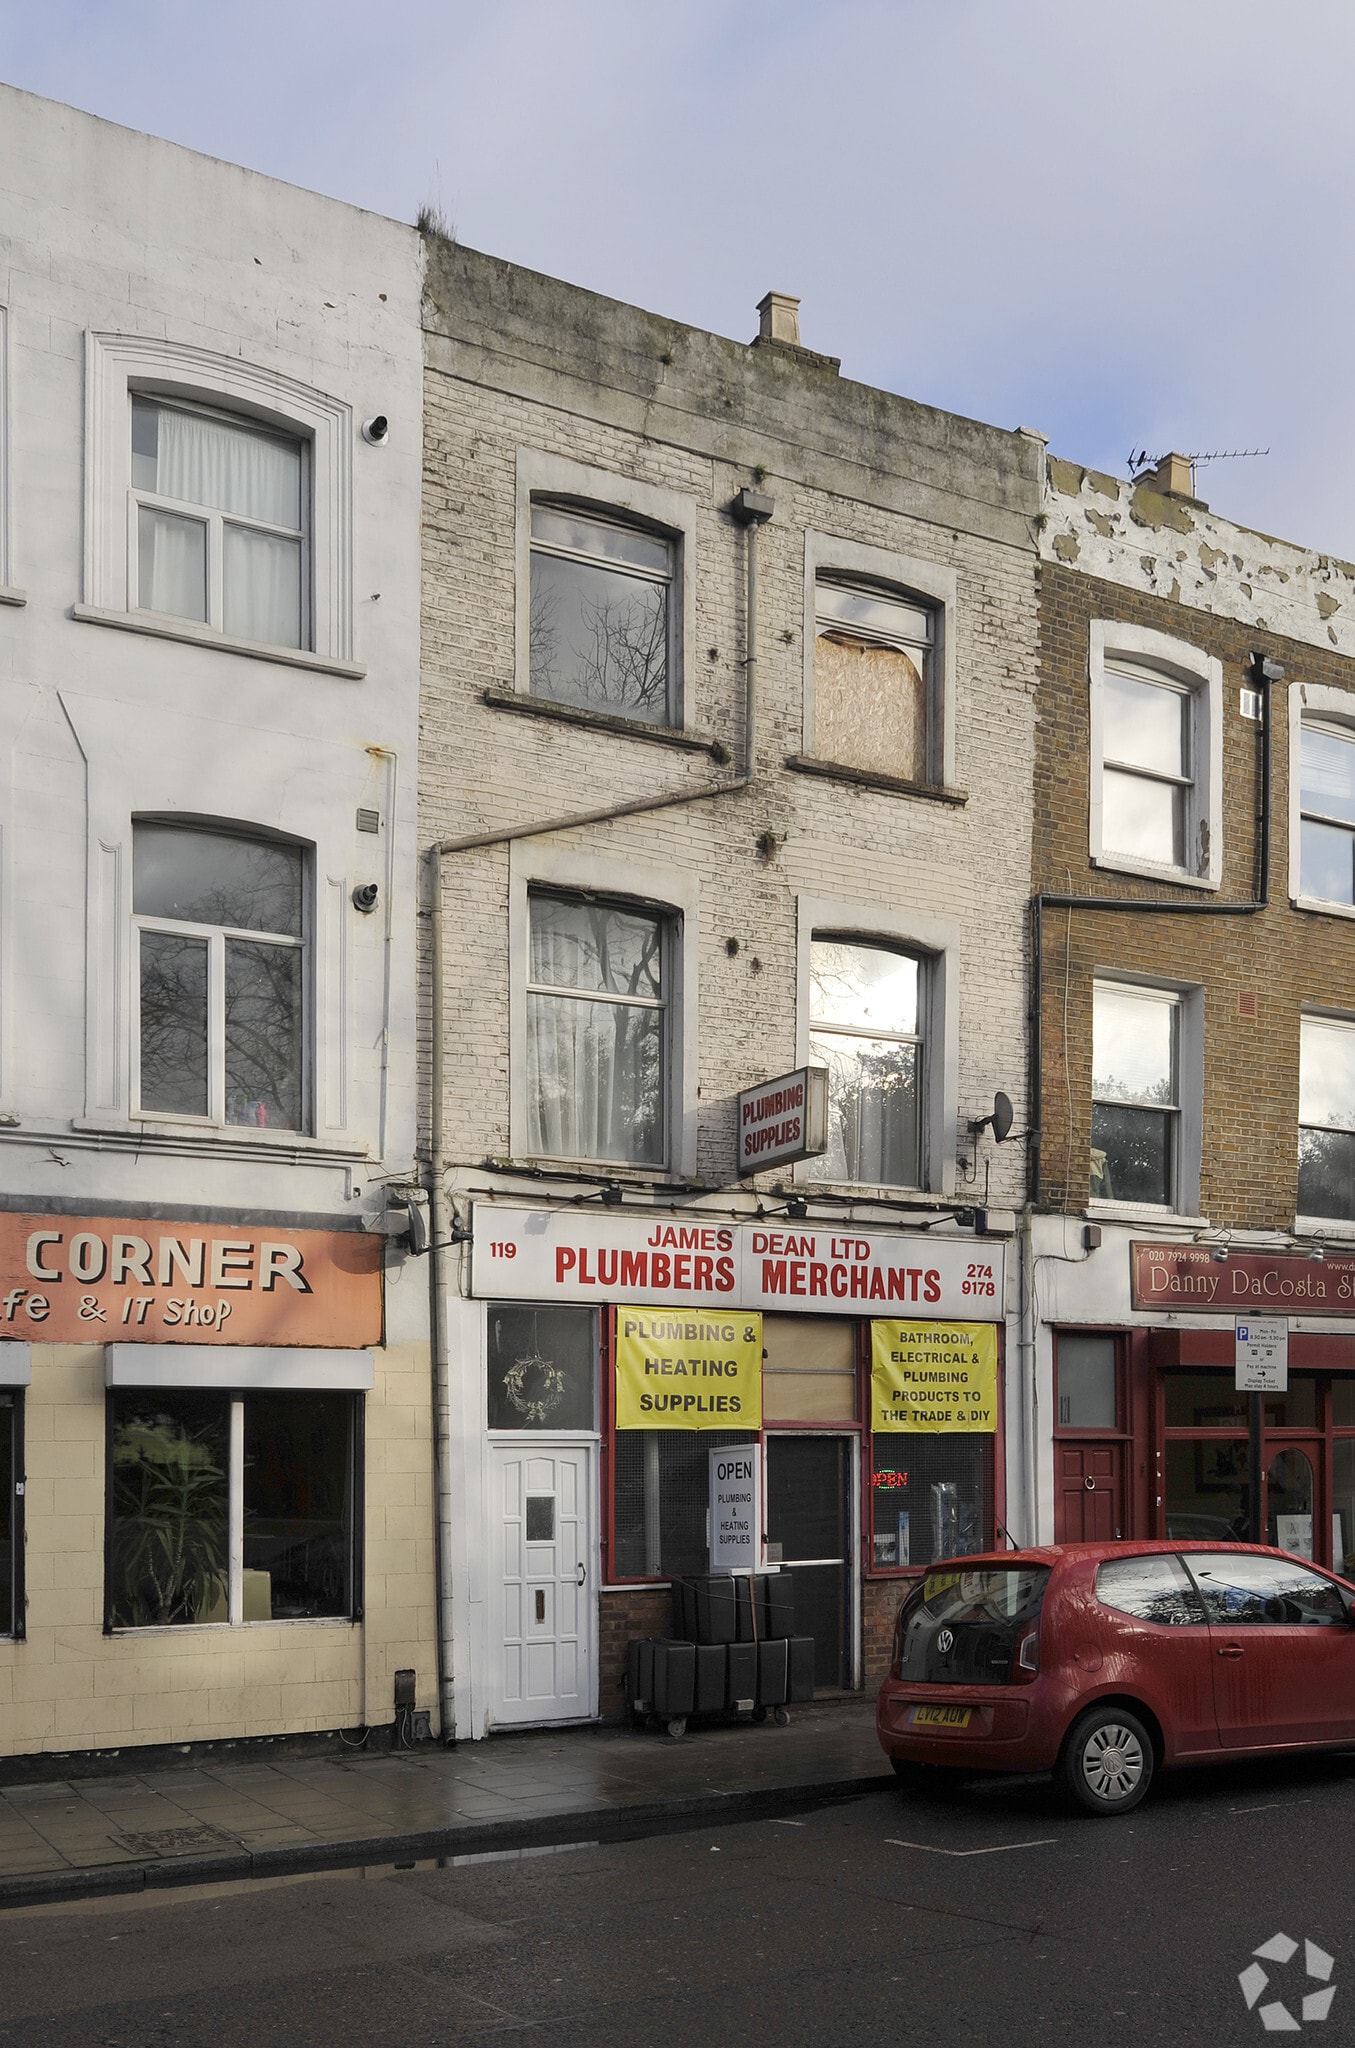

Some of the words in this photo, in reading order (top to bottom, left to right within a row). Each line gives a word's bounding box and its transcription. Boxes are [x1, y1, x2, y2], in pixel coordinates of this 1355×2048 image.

[742, 1083, 803, 1126] PLUMBING
[744, 1116, 801, 1157] SUPPLIES
[489, 1241, 517, 1259] 119
[647, 1224, 733, 1252] JAMES
[752, 1232, 816, 1258] DEAN
[830, 1238, 871, 1261] LTD
[26, 1230, 313, 1294] CORNER
[1149, 1250, 1165, 1262] 020
[1168, 1251, 1187, 1263] 7924
[1190, 1253, 1210, 1264] 9998
[555, 1246, 735, 1292] PLUMBERS
[761, 1259, 941, 1303] MERCHANTS
[966, 1263, 993, 1279] 274
[961, 1280, 995, 1297] 9178
[1150, 1266, 1220, 1303] Danny
[1231, 1269, 1327, 1299] DaCosta
[1337, 1274, 1355, 1299] S
[0, 1288, 50, 1322] fe
[77, 1294, 108, 1323] &
[121, 1296, 154, 1324] IT
[163, 1297, 232, 1331] Shop
[624, 1320, 735, 1342] PLUMBING
[742, 1326, 757, 1343] &
[900, 1332, 973, 1346] BATHROOM,
[1240, 1327, 1248, 1340] P
[891, 1351, 968, 1364] ELECTRICAL
[971, 1353, 980, 1364] &
[645, 1358, 738, 1377] HEATING
[903, 1371, 969, 1383] PLUMBING
[640, 1394, 741, 1412] SUPPLIES
[892, 1390, 960, 1402] PRODUCTS
[963, 1391, 981, 1402] TO
[881, 1409, 907, 1421] THE
[912, 1410, 952, 1421] TRADE
[956, 1410, 966, 1421] &
[971, 1410, 990, 1421] DIY
[717, 1461, 752, 1480] OPEN
[718, 1493, 752, 1504] PLUMBING
[731, 1507, 737, 1517] &
[720, 1521, 749, 1531] HEATING
[719, 1534, 751, 1545] SUPPLIES
